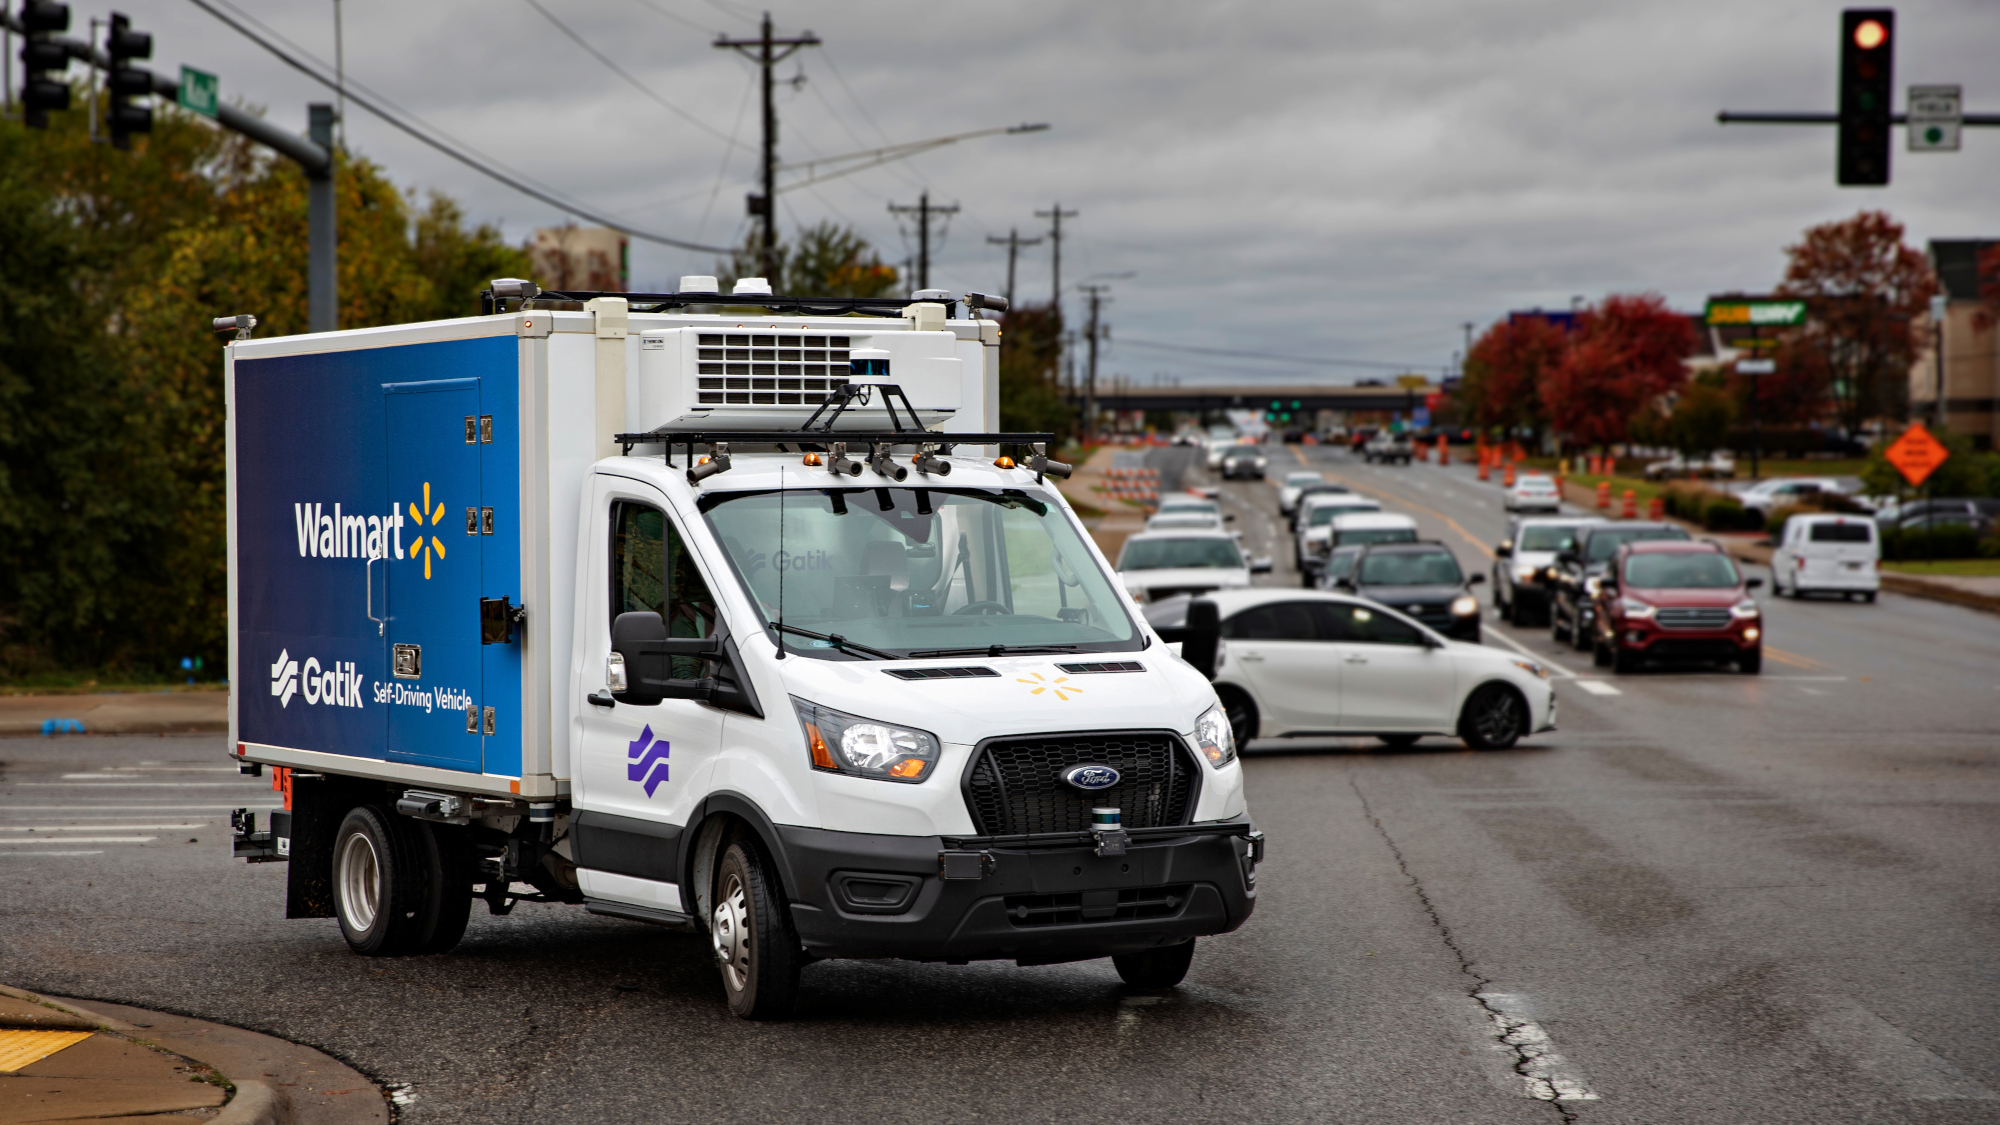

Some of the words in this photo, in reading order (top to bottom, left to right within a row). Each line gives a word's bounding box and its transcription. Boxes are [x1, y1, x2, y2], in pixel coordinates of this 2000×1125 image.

[1707, 303, 1805, 324] SUBWAY
[295, 502, 404, 560] Walmart
[772, 549, 834, 572] Gatik
[302, 656, 364, 708] Gatik
[373, 681, 433, 714] Self-Driving
[434, 686, 472, 710] Vehicle
[1081, 769, 1110, 784] Ford
